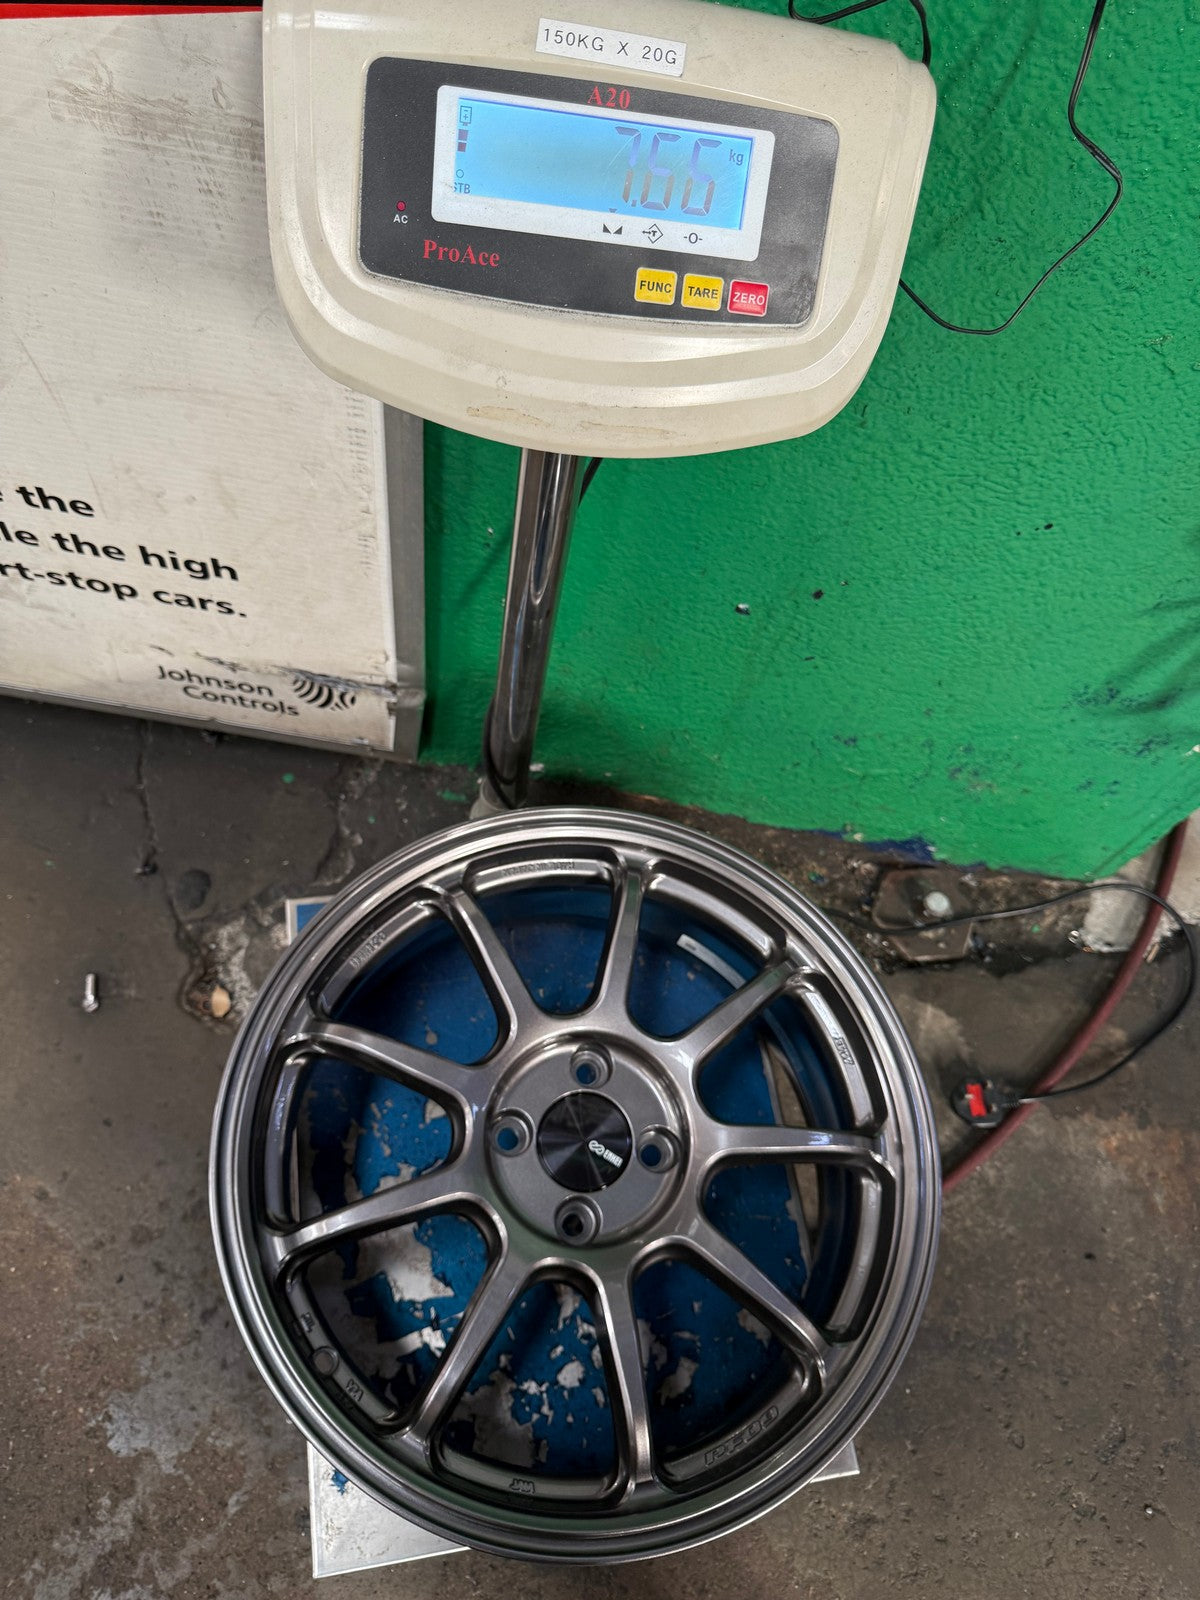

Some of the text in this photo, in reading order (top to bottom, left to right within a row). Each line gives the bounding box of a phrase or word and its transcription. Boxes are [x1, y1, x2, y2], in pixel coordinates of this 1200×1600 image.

[543, 27, 678, 66] 150KG X 20G
[587, 85, 632, 110] A20
[614, 125, 745, 217] 7.66 kg
[393, 213, 409, 225] AC
[422, 239, 501, 269] ProAce
[638, 279, 673, 296] FUNC
[687, 285, 720, 302] TARE
[732, 291, 766, 308] ZERO
[16, 486, 95, 518] the
[52, 532, 125, 561] the
[138, 545, 239, 582] high
[153, 588, 248, 618] cars.
[157, 665, 274, 696] Johnson
[182, 686, 300, 717] Controls
